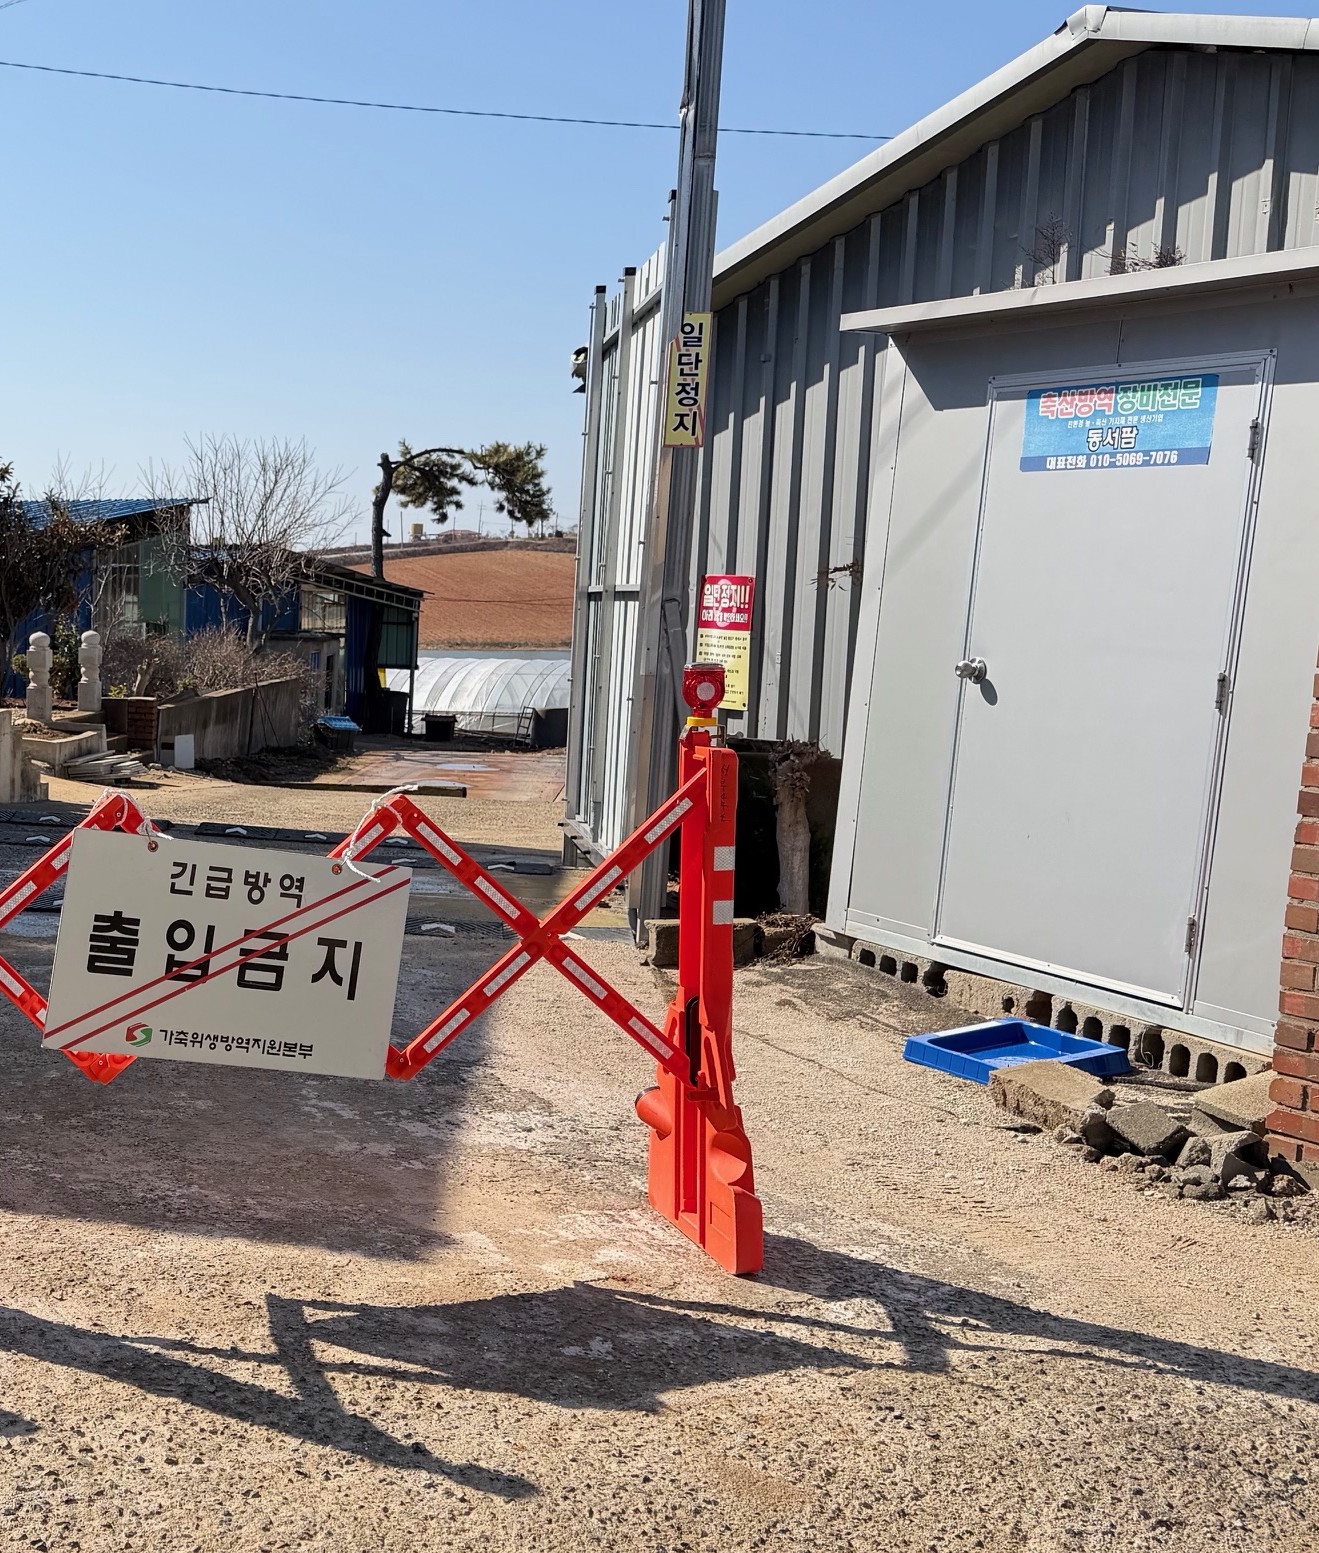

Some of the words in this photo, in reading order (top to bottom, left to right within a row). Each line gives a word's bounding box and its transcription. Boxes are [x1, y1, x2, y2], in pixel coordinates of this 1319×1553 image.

[672, 322, 703, 437] 일단정지
[1039, 387, 1115, 419] 축산방역
[1117, 379, 1201, 414] 장비전문
[1087, 426, 1138, 452] 동서팜
[1046, 454, 1087, 470] 대표전화
[1089, 450, 1178, 467] 010-5069-7076
[169, 860, 306, 908] 긴급방역
[86, 910, 363, 1001] 출입금지
[159, 1028, 314, 1060] 가축위생방역지원본부
